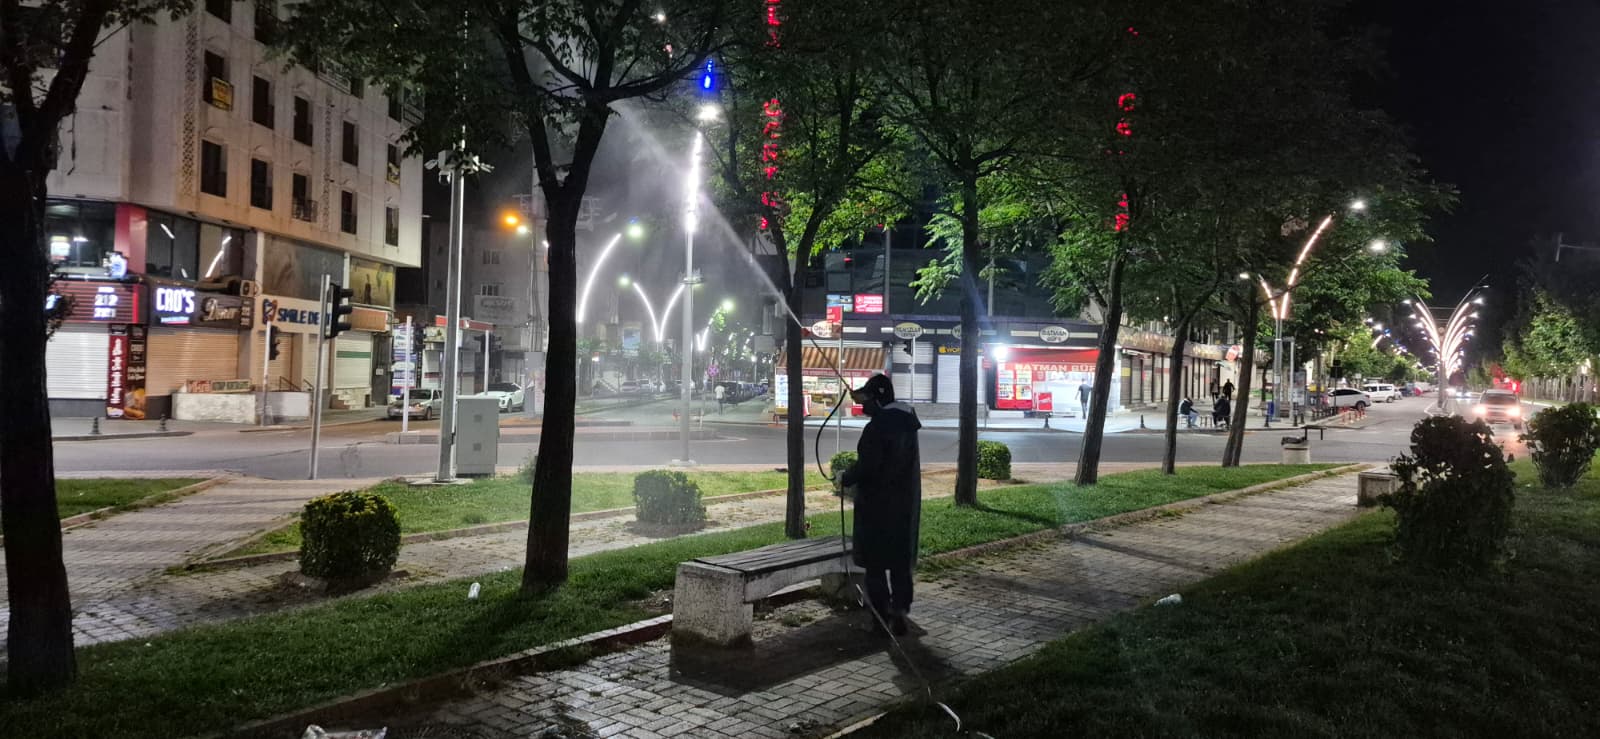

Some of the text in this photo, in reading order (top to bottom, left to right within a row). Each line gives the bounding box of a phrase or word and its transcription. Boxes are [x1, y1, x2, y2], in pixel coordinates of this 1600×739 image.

[277, 308, 306, 324] SMILE
[1015, 363, 1096, 372] BATMAN BÜF
